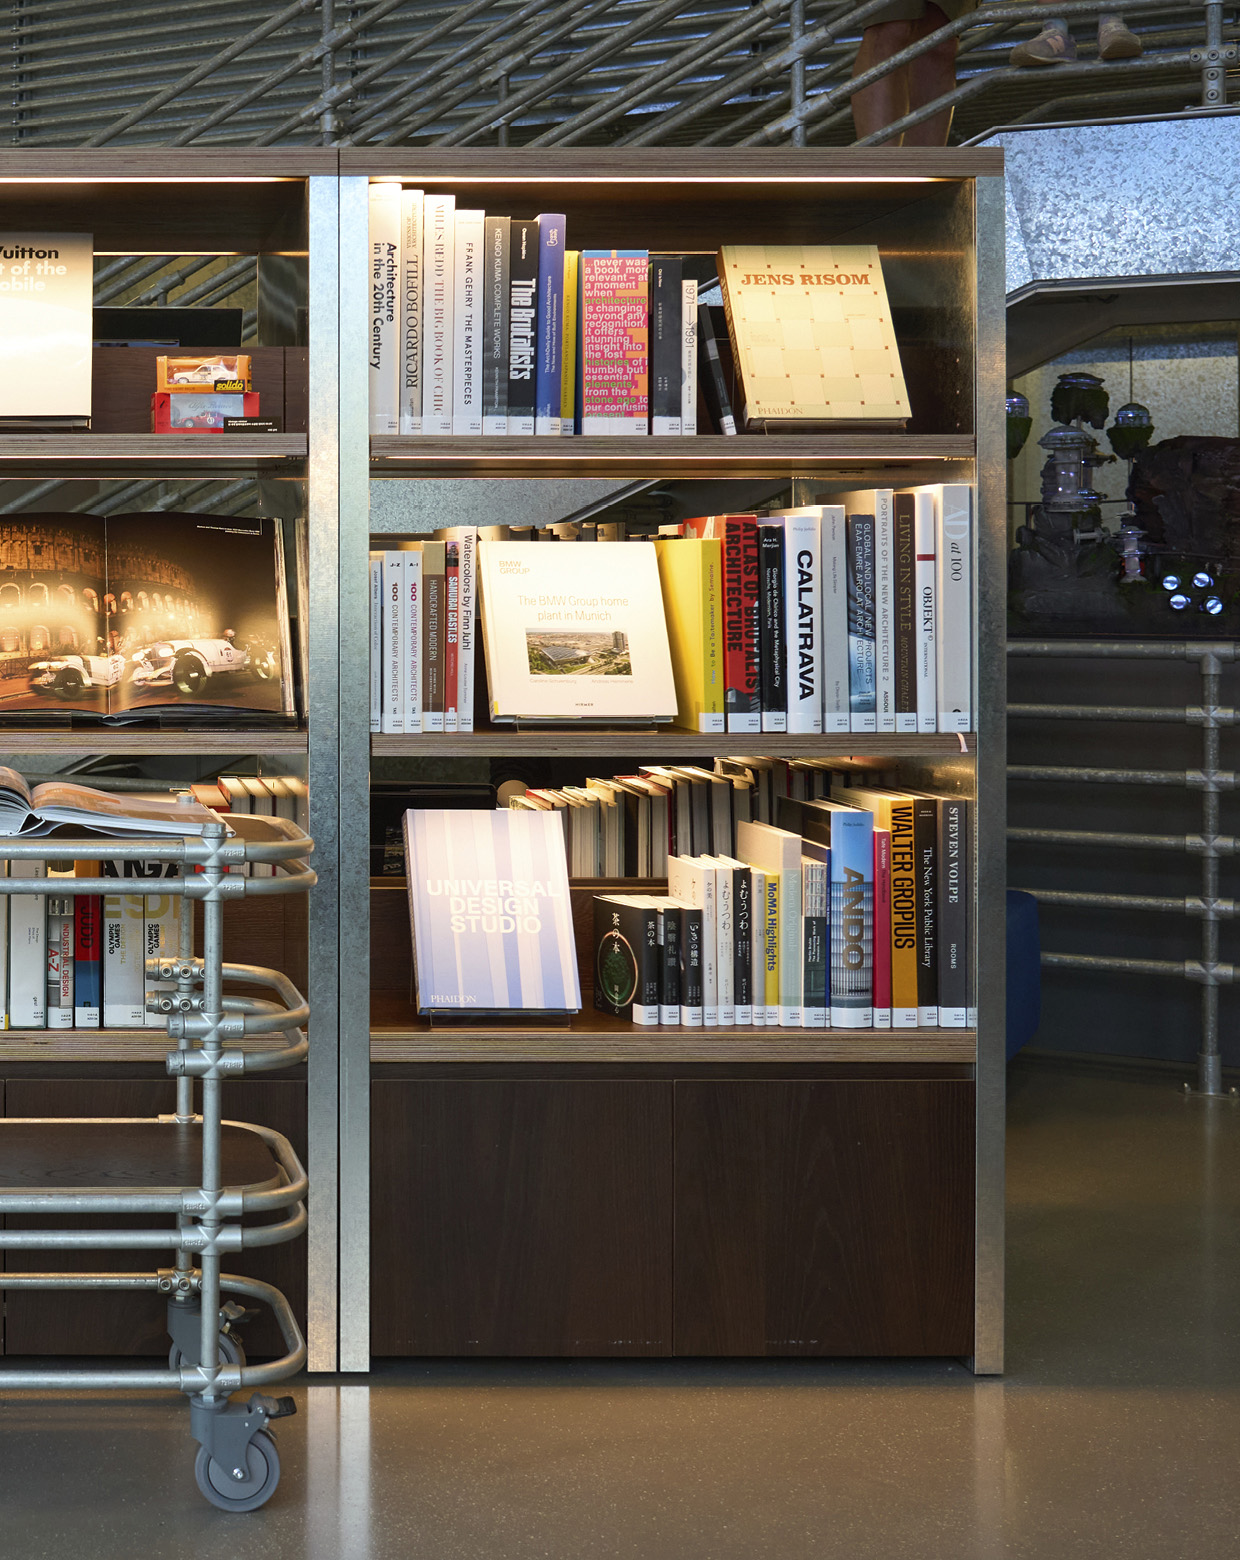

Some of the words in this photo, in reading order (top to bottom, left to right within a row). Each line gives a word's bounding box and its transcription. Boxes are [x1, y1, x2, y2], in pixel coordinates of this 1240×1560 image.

[373, 243, 383, 254] in
[465, 243, 474, 274] FRANK
[11, 261, 30, 275] of
[36, 261, 67, 275] the
[373, 259, 383, 279] the
[741, 274, 794, 285] JENS
[800, 274, 870, 286] RISOM
[386, 243, 397, 322] Architecture
[407, 255, 418, 312] BOFILL
[464, 278, 473, 308] GEHRY
[512, 278, 535, 306] The
[373, 284, 383, 313] 20th
[585, 296, 646, 304] architecture
[464, 315, 473, 332] THE
[370, 318, 383, 370] Century
[406, 316, 418, 388] RICARDO
[509, 308, 534, 380] Brutalists
[585, 335, 630, 344] stunning
[585, 342, 622, 352] insight
[464, 336, 472, 405] MASTERPIECES
[758, 407, 803, 415] PHAIDON
[743, 522, 758, 576] ATLAS
[951, 542, 962, 554] at
[463, 535, 472, 593] Watercolors
[951, 557, 962, 581] 100
[448, 577, 458, 611] SAMURAI
[725, 522, 743, 652] ARCHITECTURE
[744, 580, 758, 601] OF
[462, 596, 472, 607] by
[518, 595, 536, 606] The
[539, 596, 566, 606] BMW
[569, 596, 598, 608] Group
[601, 596, 628, 606] home
[448, 612, 458, 643] CASTLES
[463, 610, 471, 630] Finn
[538, 612, 561, 622] plant
[565, 612, 573, 620] in
[575, 611, 611, 621] Munich
[797, 550, 814, 700] CALATRAVA
[462, 632, 471, 650] Juhl
[744, 606, 760, 697] BRUTALIST
[892, 806, 913, 872] WALTER
[949, 807, 959, 858] STEVEN
[923, 847, 932, 864] The
[427, 880, 562, 897] UNIVERSAL
[924, 866, 932, 885] New
[949, 862, 958, 903] VOLPE
[450, 898, 539, 915] DESIGN
[768, 883, 776, 915] MoMA
[924, 888, 932, 907] York
[450, 915, 541, 934] STUDIO
[843, 867, 864, 971] ANDO
[893, 877, 915, 949] GROPIUS
[924, 909, 932, 934] Public
[80, 906, 94, 948] JUDD
[61, 924, 70, 968] INDUSTRIAL
[766, 918, 777, 971] Highlights
[922, 937, 932, 968] Library
[949, 944, 957, 969] ROOMS
[48, 949, 59, 972] A-Z
[62, 970, 70, 997] DESIGN
[431, 995, 476, 1003] PHAIDON
